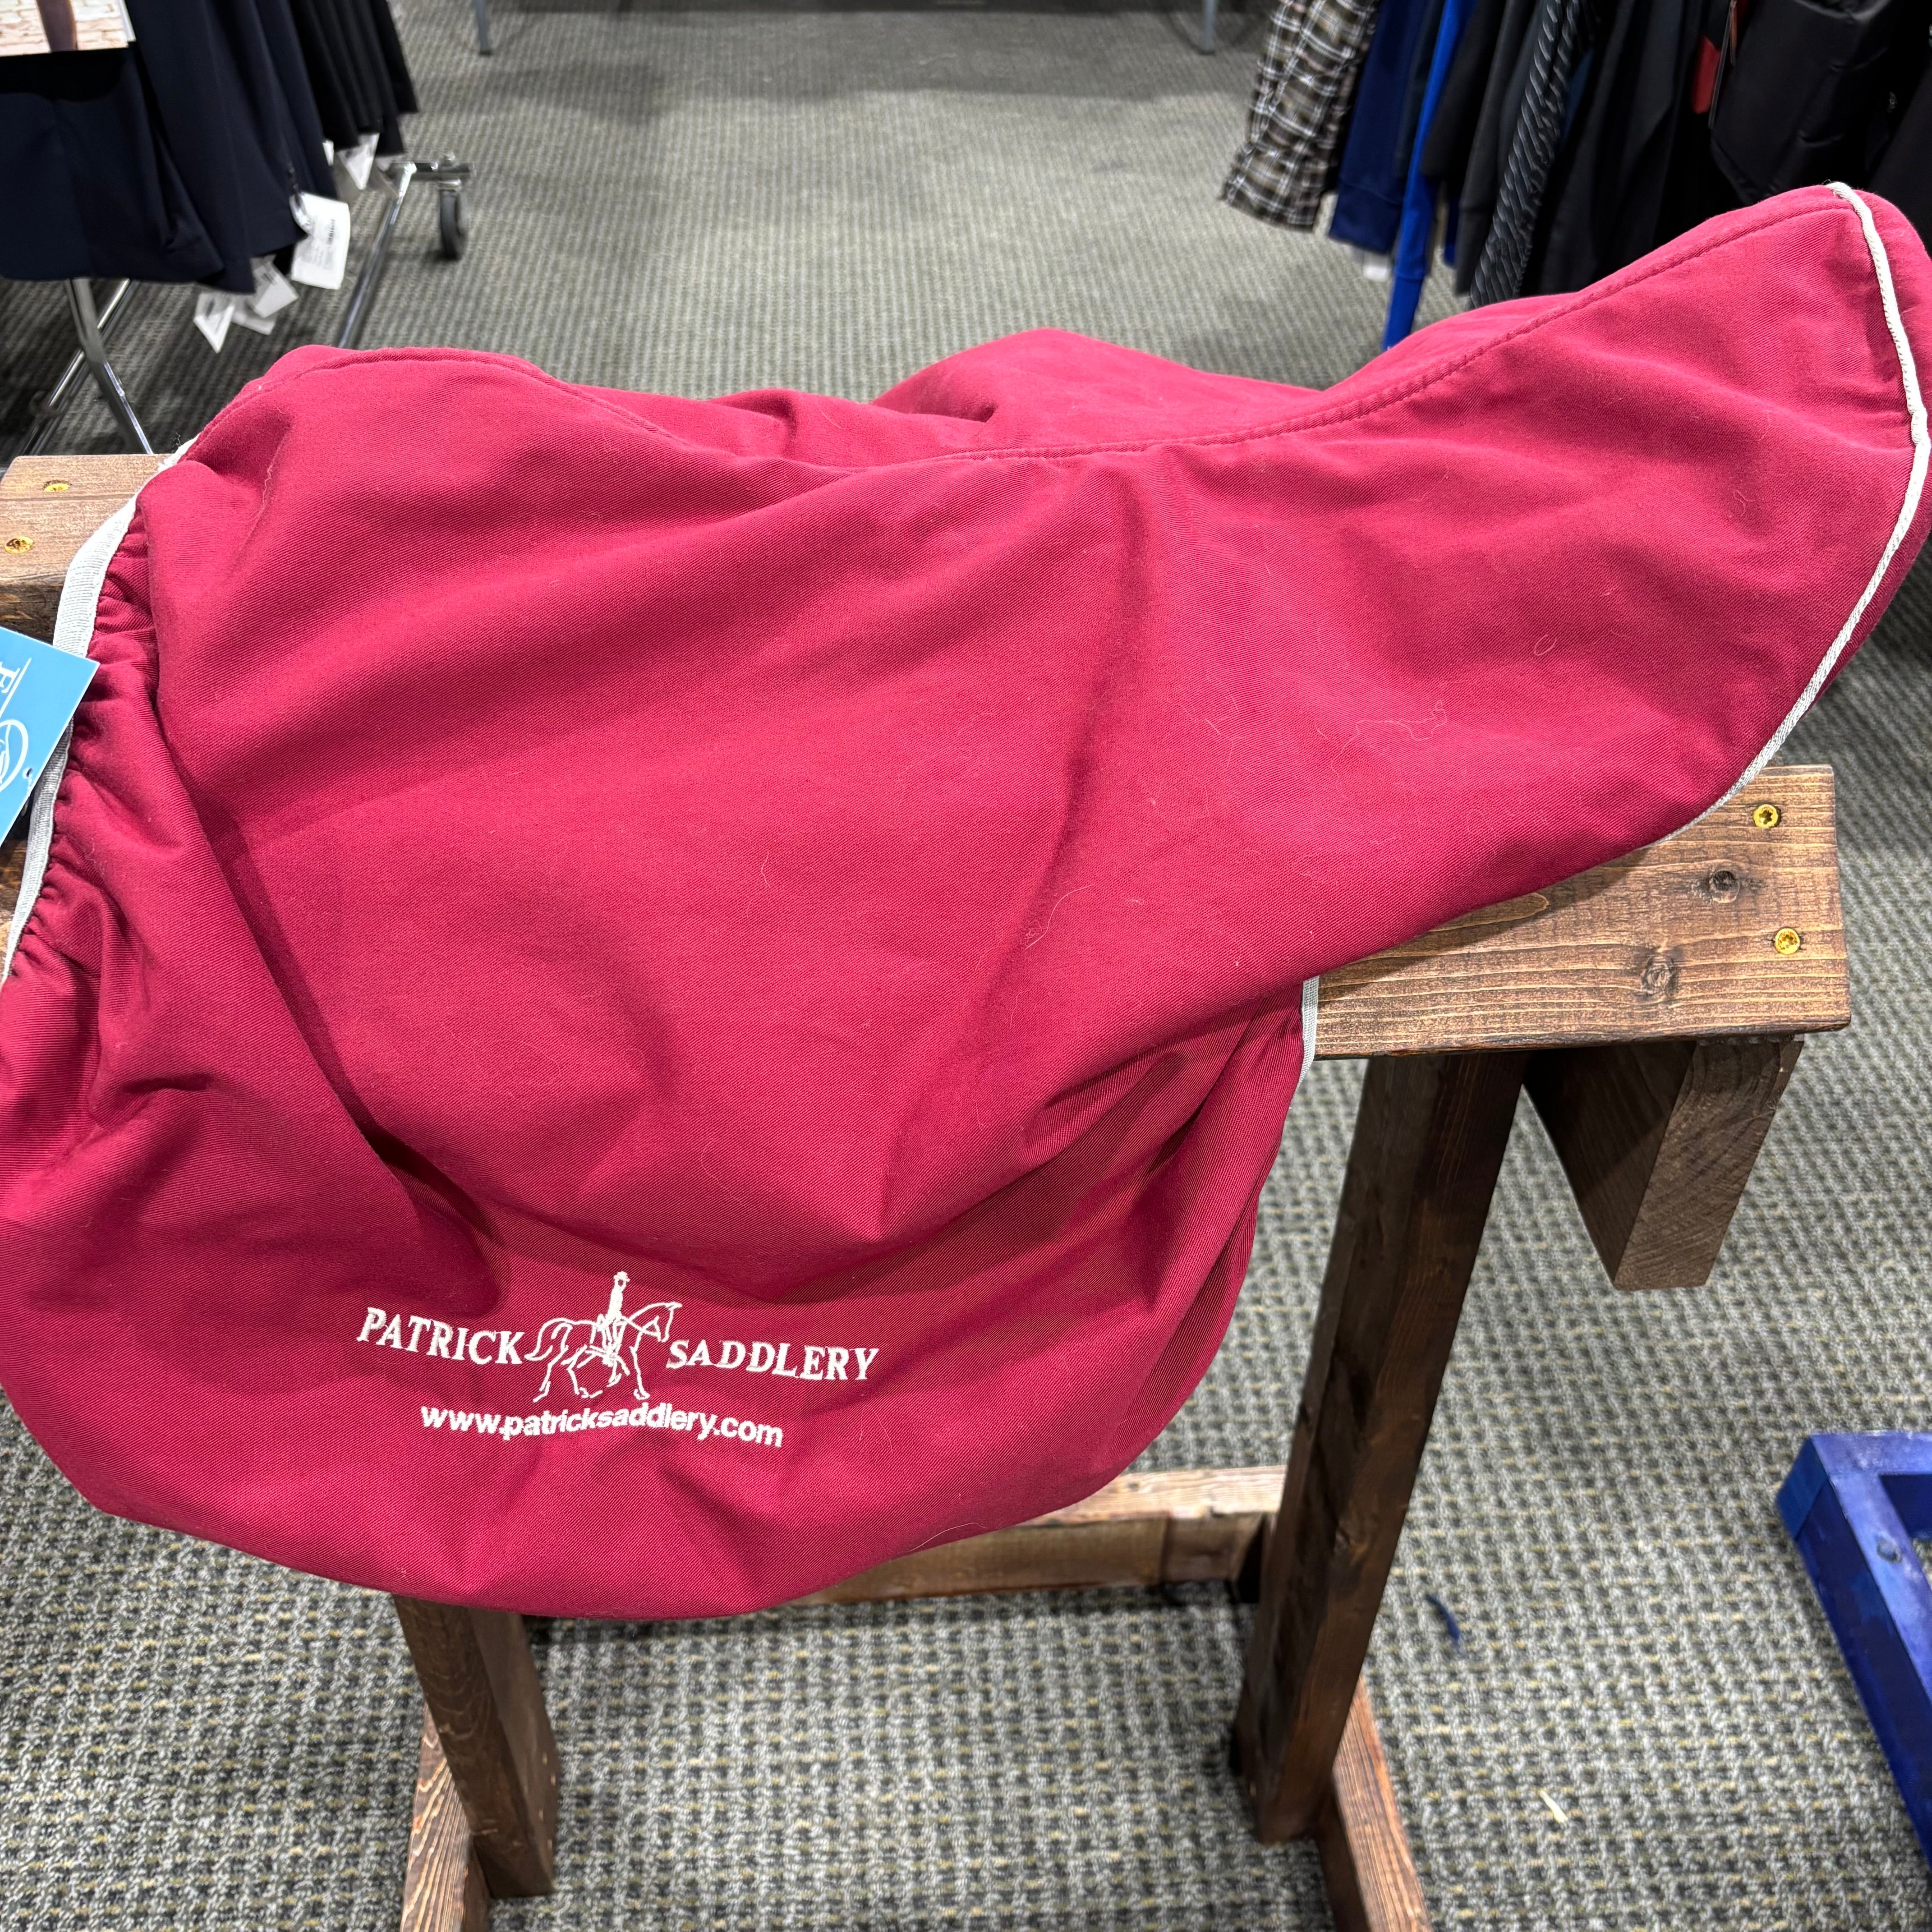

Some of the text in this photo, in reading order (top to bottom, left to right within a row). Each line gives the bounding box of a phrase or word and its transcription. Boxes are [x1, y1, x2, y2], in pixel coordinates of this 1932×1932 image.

[356, 1306, 879, 1381] PATRICK SADDLERY
[420, 1401, 784, 1448] www.patricksaddlery.com
